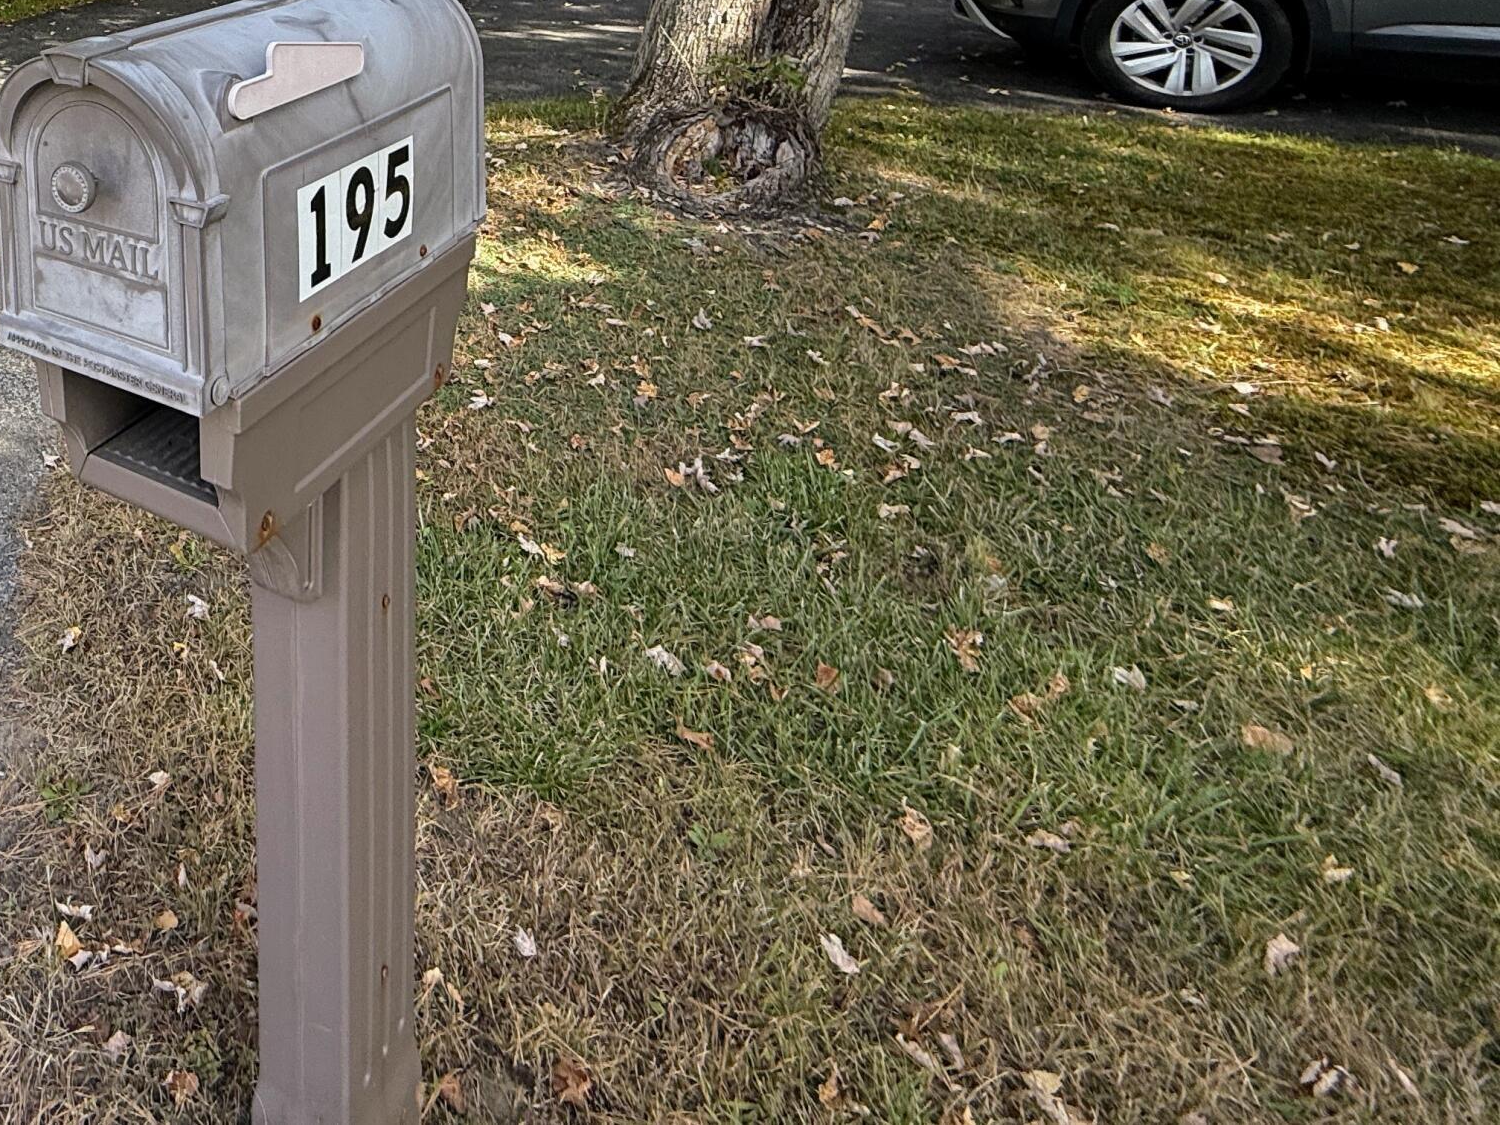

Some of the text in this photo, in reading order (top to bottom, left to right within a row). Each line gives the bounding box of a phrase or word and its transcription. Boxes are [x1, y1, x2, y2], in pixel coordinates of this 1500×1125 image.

[39, 220, 159, 280] US MAIL
[310, 144, 410, 288] 195
